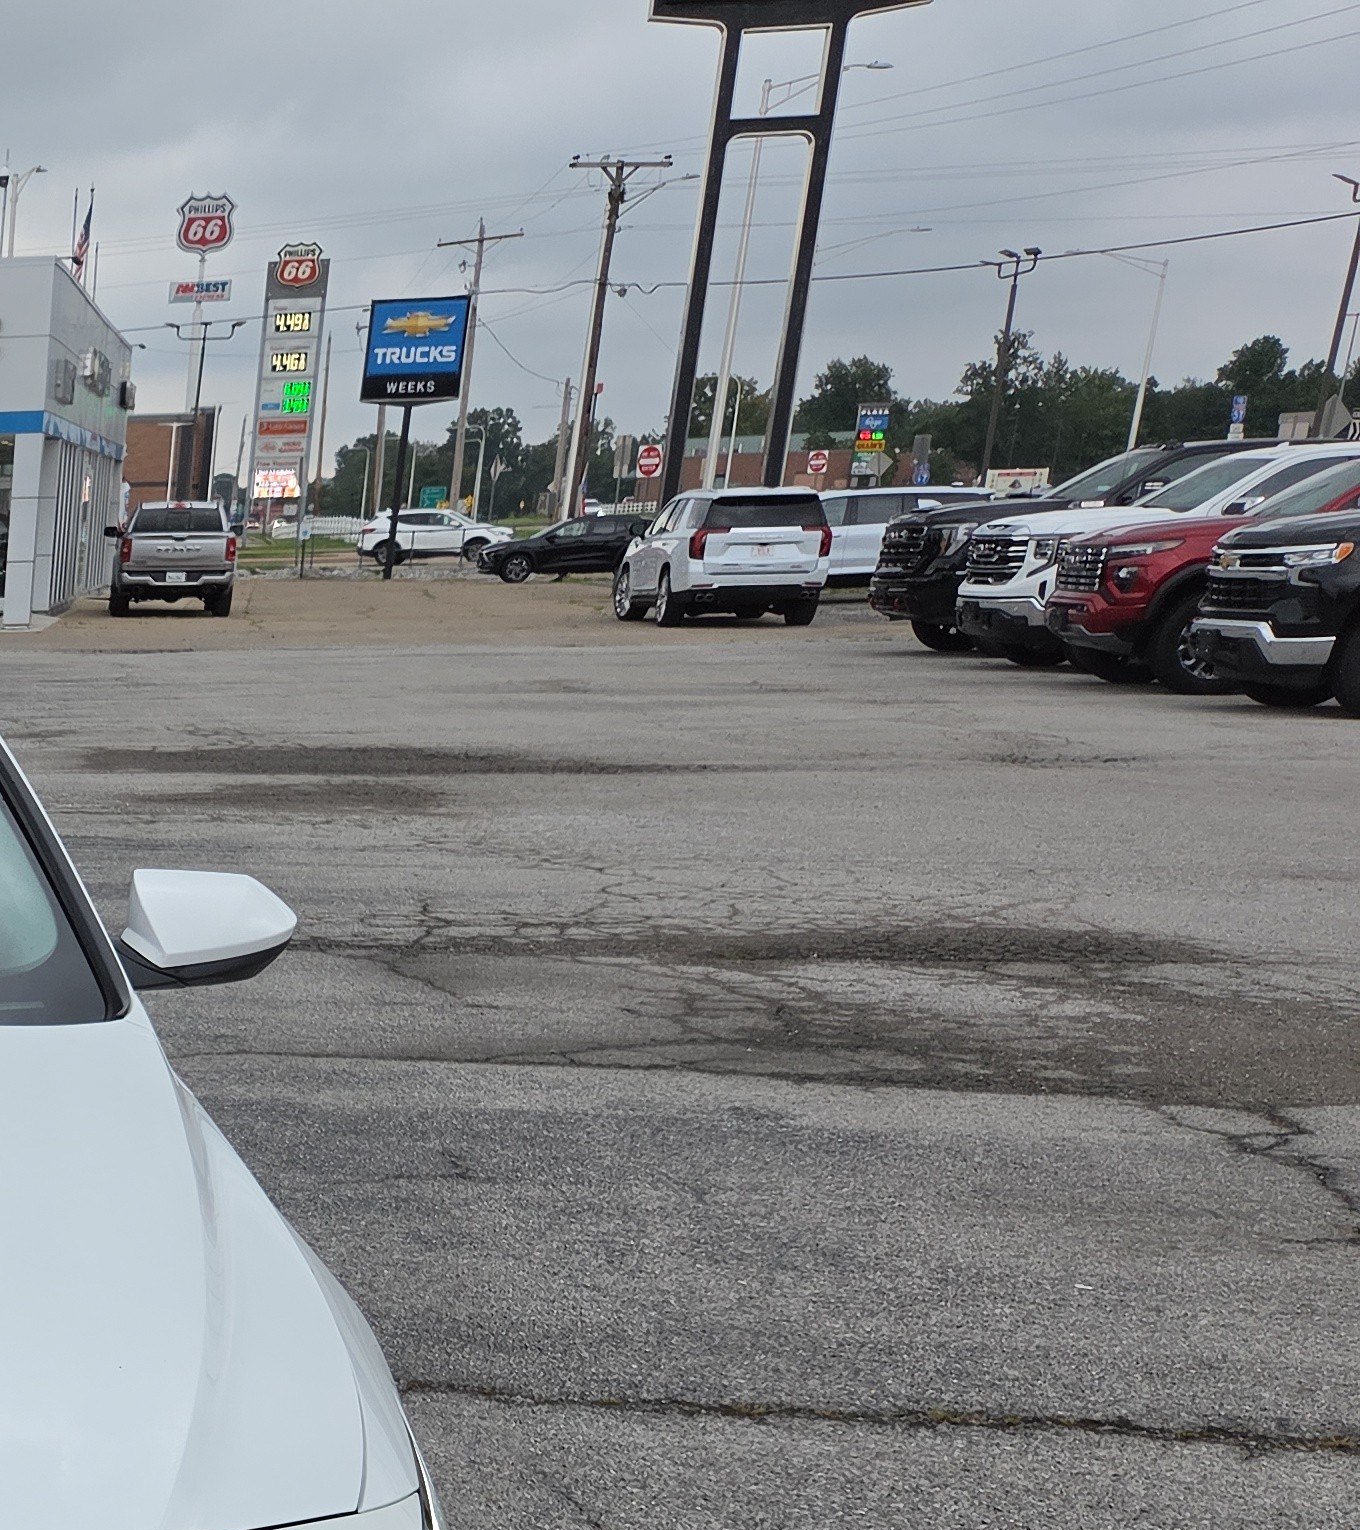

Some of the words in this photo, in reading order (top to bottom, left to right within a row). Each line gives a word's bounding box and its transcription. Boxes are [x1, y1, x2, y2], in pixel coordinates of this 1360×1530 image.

[188, 203, 226, 214] PHILLIPS
[188, 218, 223, 241] 66
[284, 248, 316, 258] PHILLIPS
[283, 261, 314, 280] 66
[373, 345, 457, 365] TRUCKS
[386, 380, 436, 394] WEEKS
